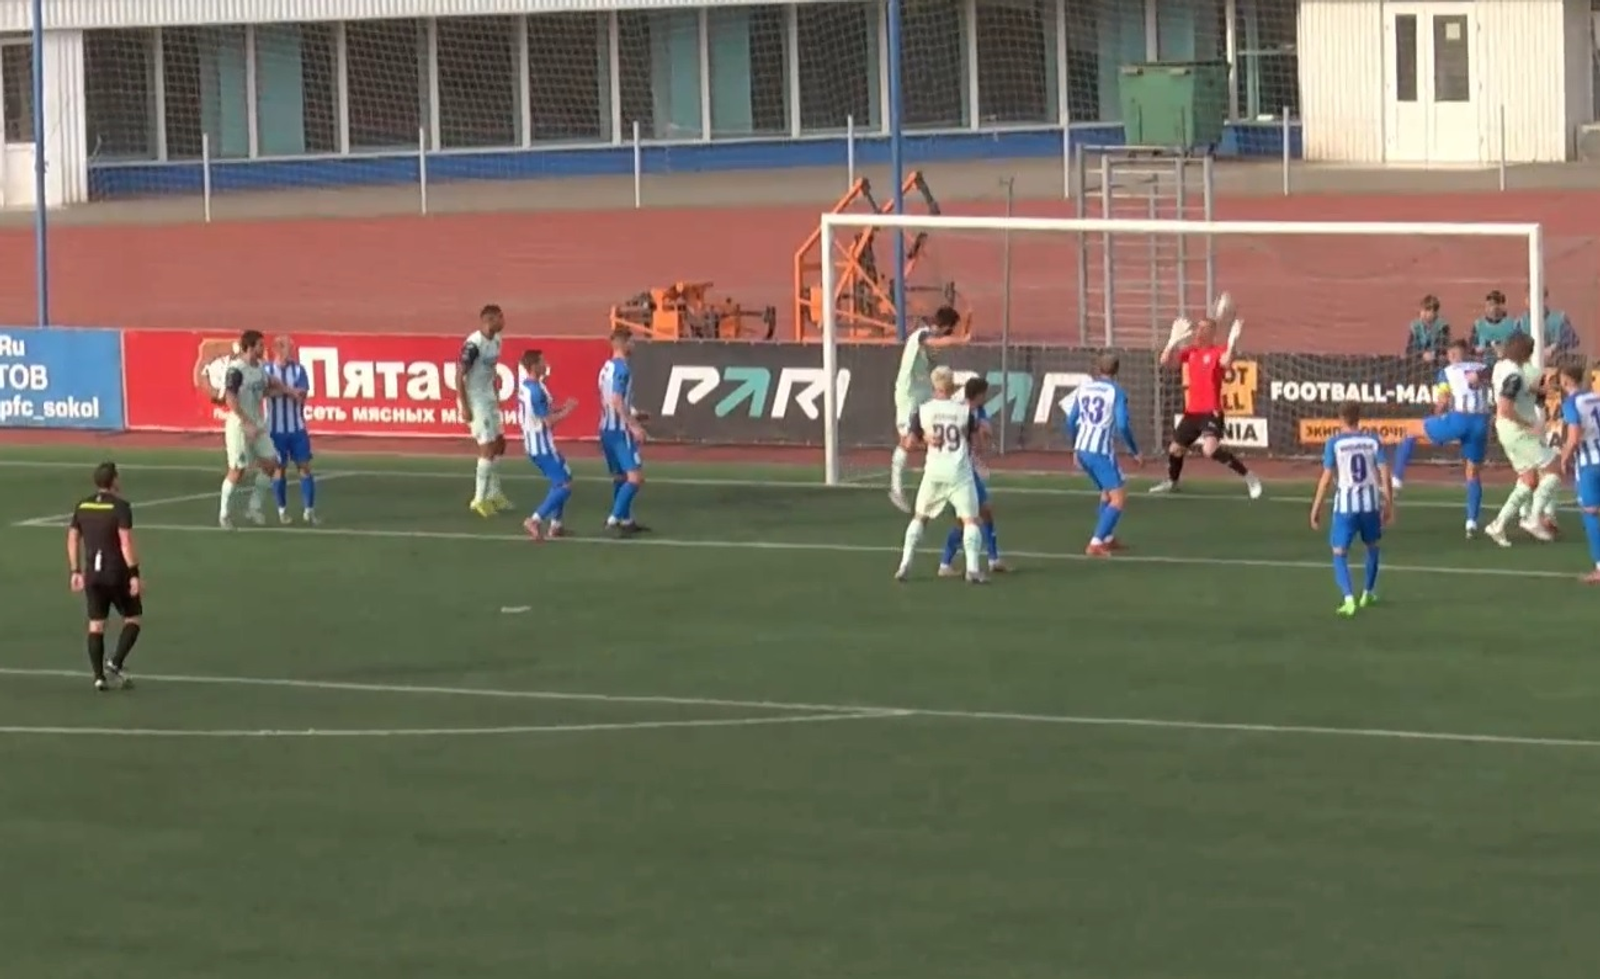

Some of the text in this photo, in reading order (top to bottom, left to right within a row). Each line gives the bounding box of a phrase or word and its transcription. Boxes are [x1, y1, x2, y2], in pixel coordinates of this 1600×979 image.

[352, 407, 436, 425] мясных
[1080, 394, 1106, 425] 33
[1350, 452, 1367, 484] 9
